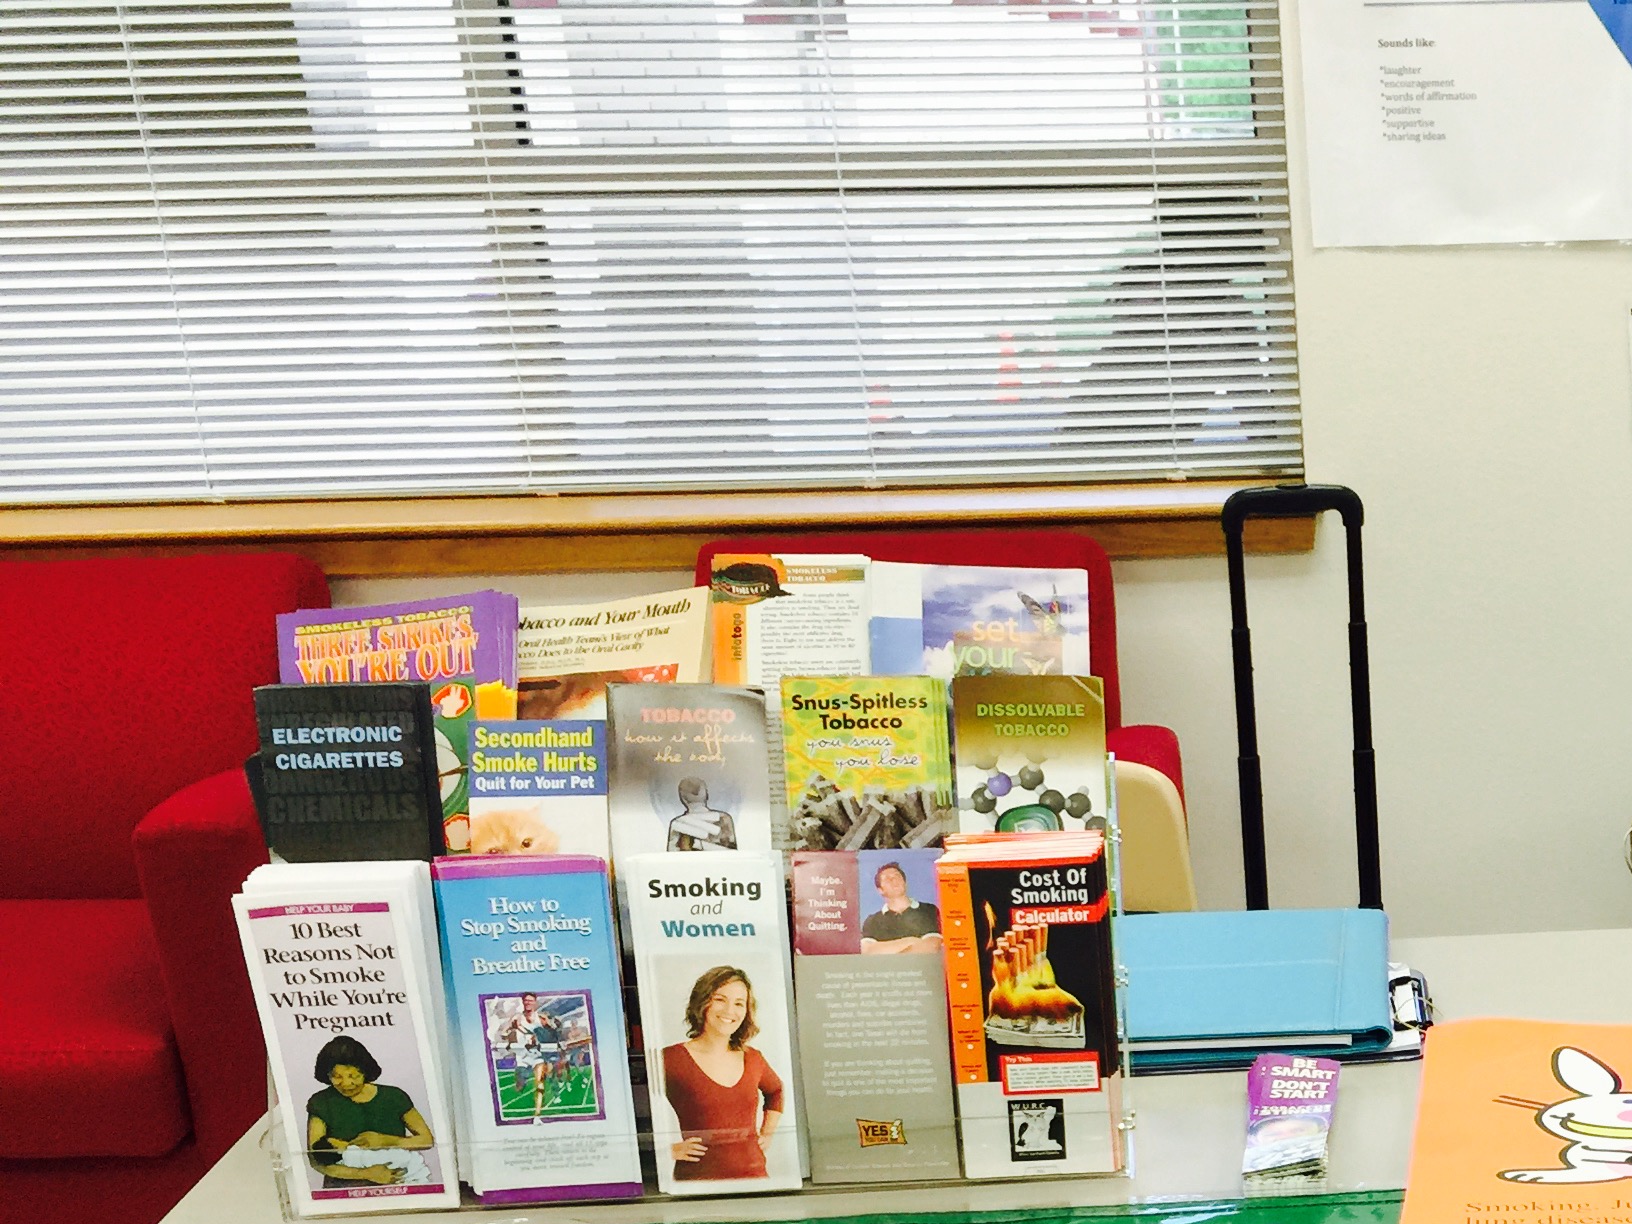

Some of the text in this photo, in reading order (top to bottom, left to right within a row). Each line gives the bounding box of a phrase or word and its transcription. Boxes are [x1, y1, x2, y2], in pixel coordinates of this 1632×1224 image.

[1378, 38, 1413, 48] Sounds
[785, 567, 838, 575] SMOKELESS
[786, 575, 827, 583] TOBACCO
[569, 611, 601, 627] and
[604, 609, 641, 625] Your
[642, 597, 692, 619] Mouth
[295, 617, 393, 636] SMOKELESS
[971, 616, 1019, 643] set
[294, 627, 373, 661] THREE
[518, 639, 541, 648] Oral
[542, 636, 574, 648] Health
[610, 632, 632, 642] View
[633, 631, 644, 641] of
[645, 625, 671, 637] What
[538, 648, 562, 658] Does
[574, 645, 590, 655] the
[591, 643, 615, 653] Oral
[296, 638, 476, 683] YOU'RE OUT
[949, 644, 1021, 676] your
[791, 693, 928, 716] Snus-Spitless
[976, 703, 1086, 718] DISSOLVABLE
[640, 707, 736, 724] TOBACCO
[819, 713, 903, 731] Tobacco
[271, 726, 404, 745] ELECTRONIC
[474, 726, 593, 749] Secondhand
[624, 729, 663, 743] how
[670, 732, 687, 743] it
[994, 723, 1069, 737] TOBACCO
[806, 736, 893, 750] you snus
[275, 751, 405, 770] CIGARETTES
[472, 751, 598, 773] Smoke Hurts
[654, 745, 682, 763] the
[835, 749, 921, 774] you lose
[475, 775, 595, 792] Quit for Your Pet
[811, 876, 844, 886] Maybe.
[1019, 867, 1088, 888] Cost Of
[648, 876, 762, 901] Smoking
[819, 887, 836, 896] I'm
[1011, 885, 1088, 906] Smoking
[306, 904, 331, 914] YOUR
[488, 896, 560, 915] How to
[690, 900, 724, 916] and
[808, 899, 848, 910] Thinking
[814, 910, 842, 919] About
[1015, 908, 1090, 925] Calculator
[289, 922, 363, 940] 10 Best
[460, 913, 592, 941] Stop Smoking
[660, 919, 756, 938] Women
[807, 921, 848, 932] Quitting.
[511, 933, 548, 953] and
[263, 943, 396, 964] Reasons Not
[472, 953, 591, 976] Breathe Free
[283, 966, 386, 985] to Smoke
[269, 988, 407, 1009] While You're
[293, 1011, 396, 1034] Pregnant
[1270, 1065, 1337, 1080] SMART
[1292, 1057, 1318, 1070] BE
[1269, 1089, 1329, 1099] START
[1271, 1079, 1331, 1091] DON'T
[862, 1124, 889, 1137] YES
[1464, 1201, 1600, 1214] Smoking.
